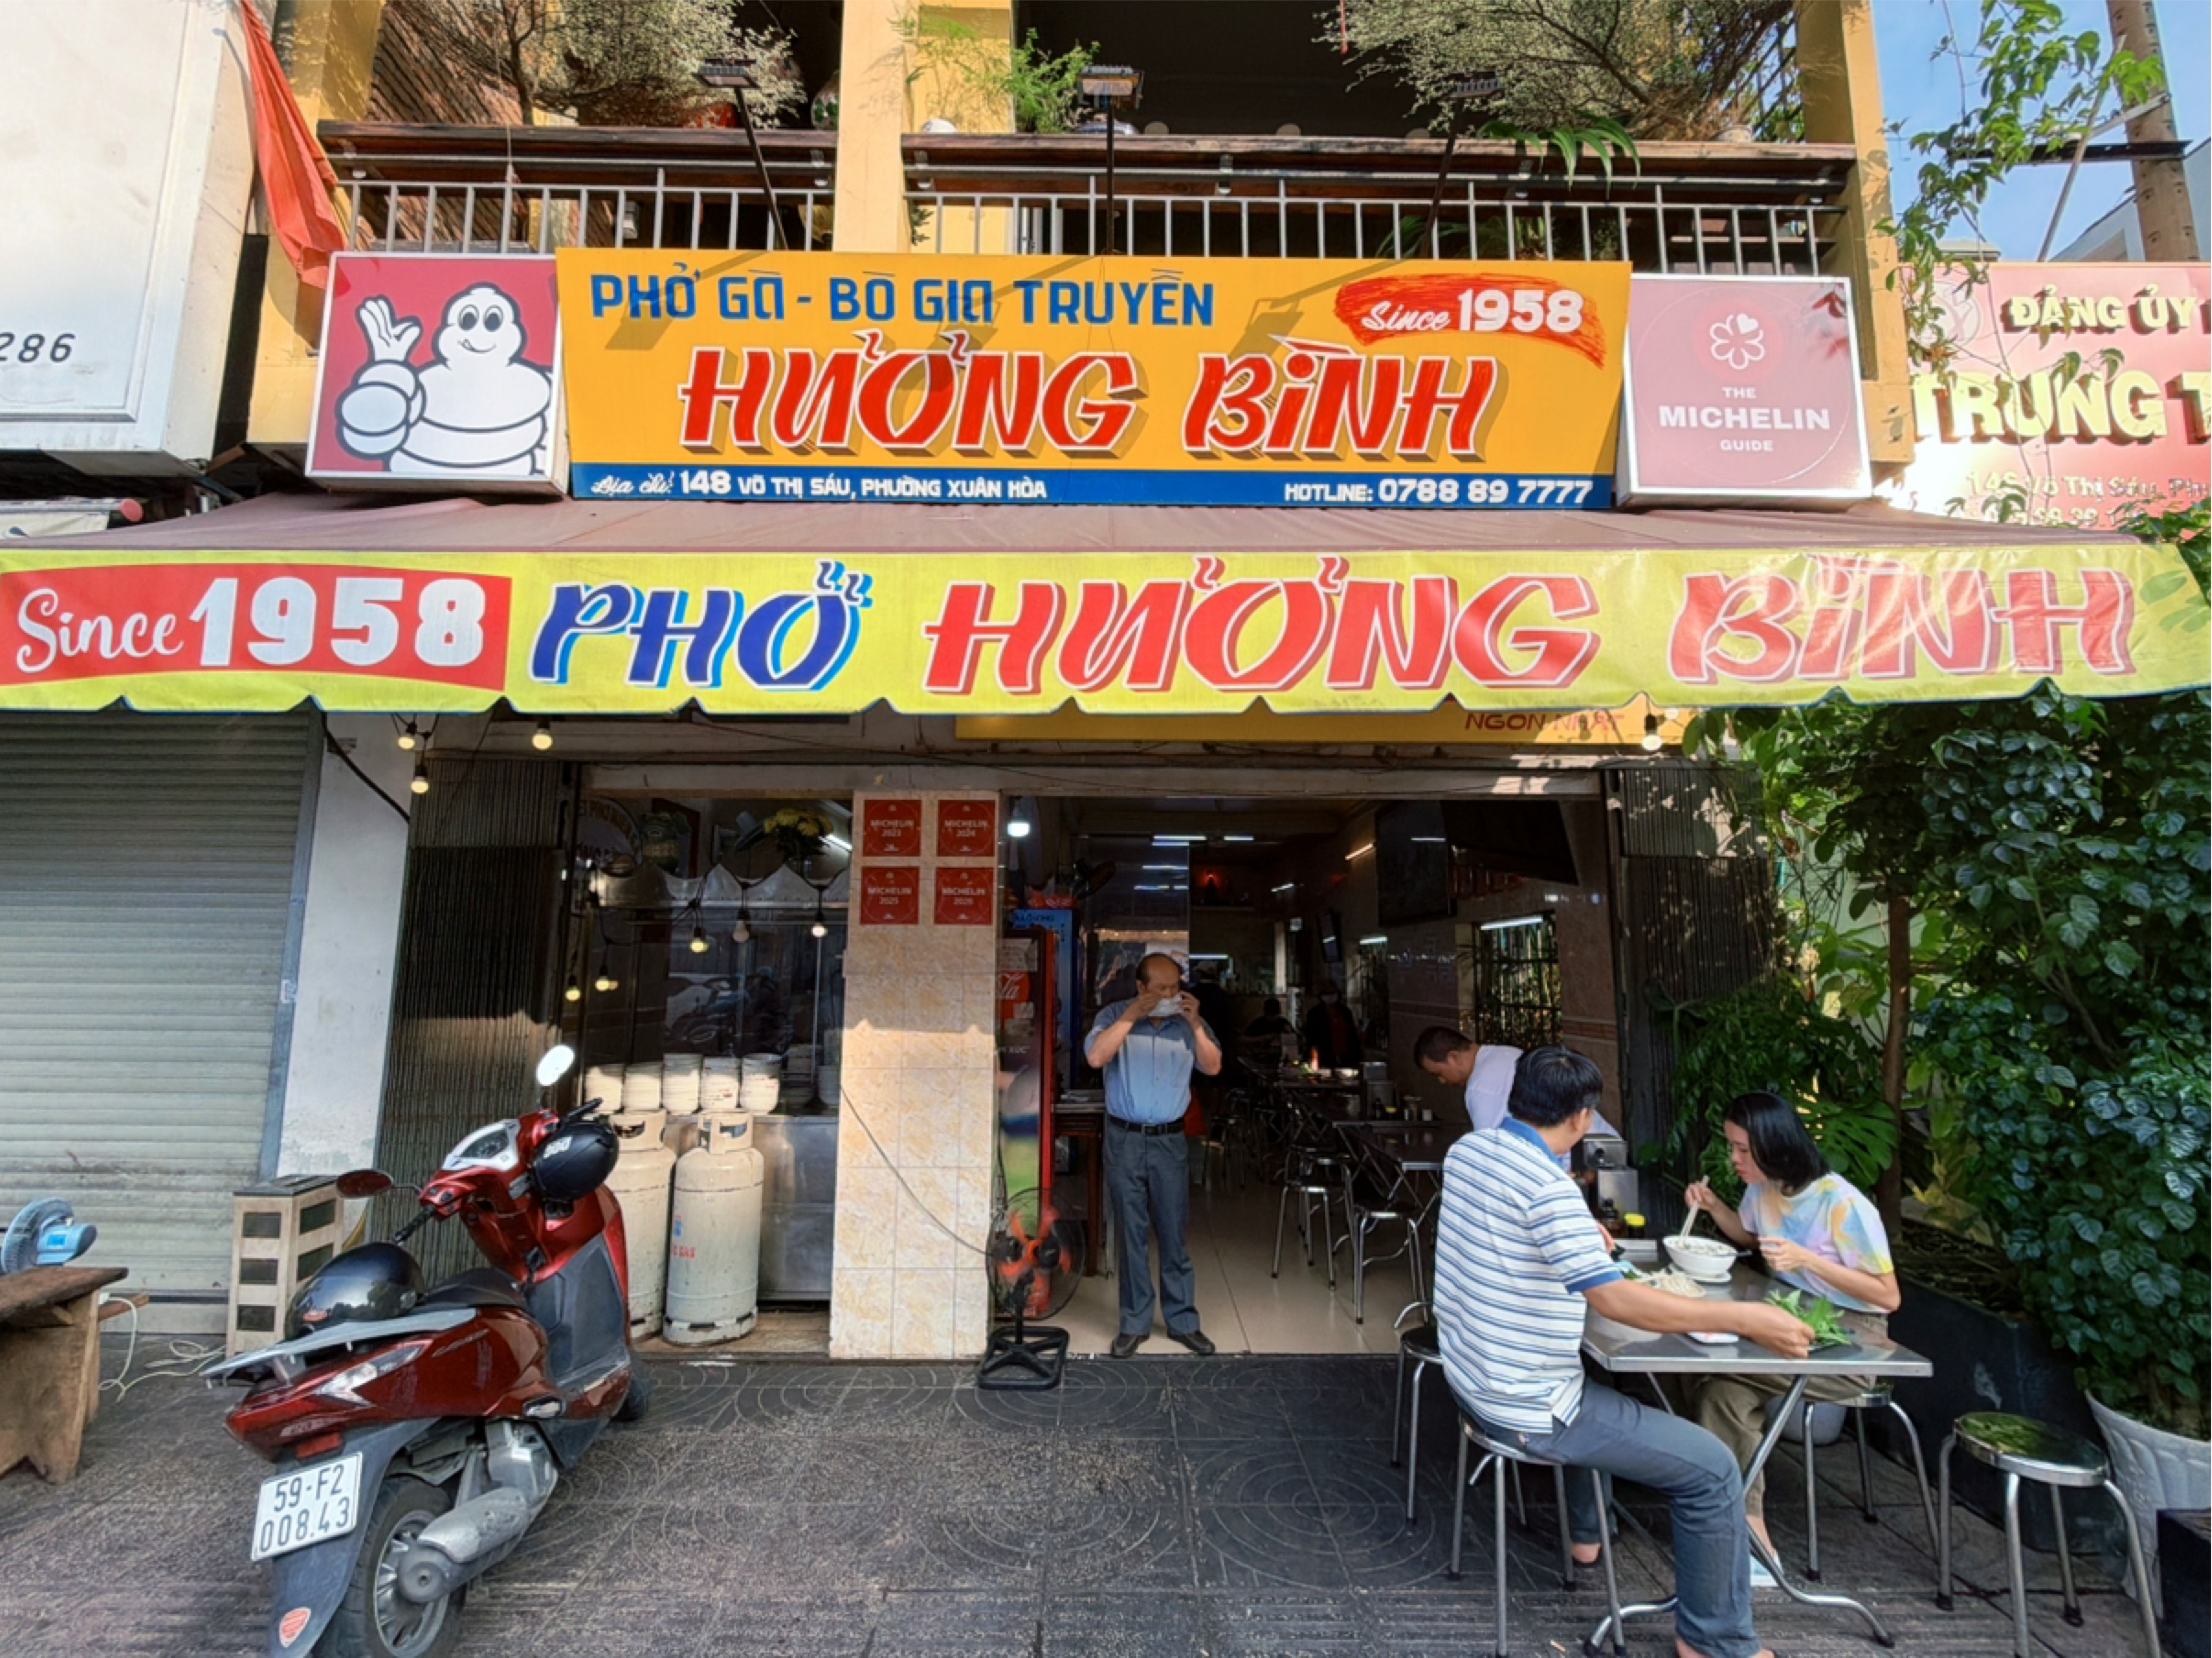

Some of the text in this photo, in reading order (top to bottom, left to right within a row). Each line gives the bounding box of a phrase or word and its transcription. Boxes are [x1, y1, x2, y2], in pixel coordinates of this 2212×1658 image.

[591, 262, 701, 319] PHỞ
[830, 271, 898, 322] BÒ
[913, 278, 994, 324] GIA
[1012, 268, 1215, 326] TRUYỀN
[1361, 289, 1585, 334] Since 1958
[0, 331, 76, 363] 286
[1721, 386, 1756, 399] THE
[1659, 405, 1830, 429] MICHELIN
[1720, 440, 1774, 452] GUIDE
[680, 470, 731, 494] 148
[738, 474, 765, 495] VÕ
[771, 477, 803, 499] THỊ
[811, 473, 856, 499] SÁU,
[948, 476, 1002, 498] XUÂN
[1008, 475, 1047, 499] HÒA
[1285, 478, 1593, 504] HOTLINE: 0788 89 7777
[17, 588, 185, 674] Since
[189, 576, 486, 667] 1958
[528, 558, 874, 692] PHỞ
[1465, 712, 1547, 731] NGON
[870, 819, 915, 828] MICHELIN
[945, 819, 988, 828] MICHELIN
[868, 887, 912, 896] MICHELIN
[942, 887, 986, 896] MICHELIN
[273, 1463, 344, 1512] 59-F2
[259, 1496, 350, 1552] 008.43
